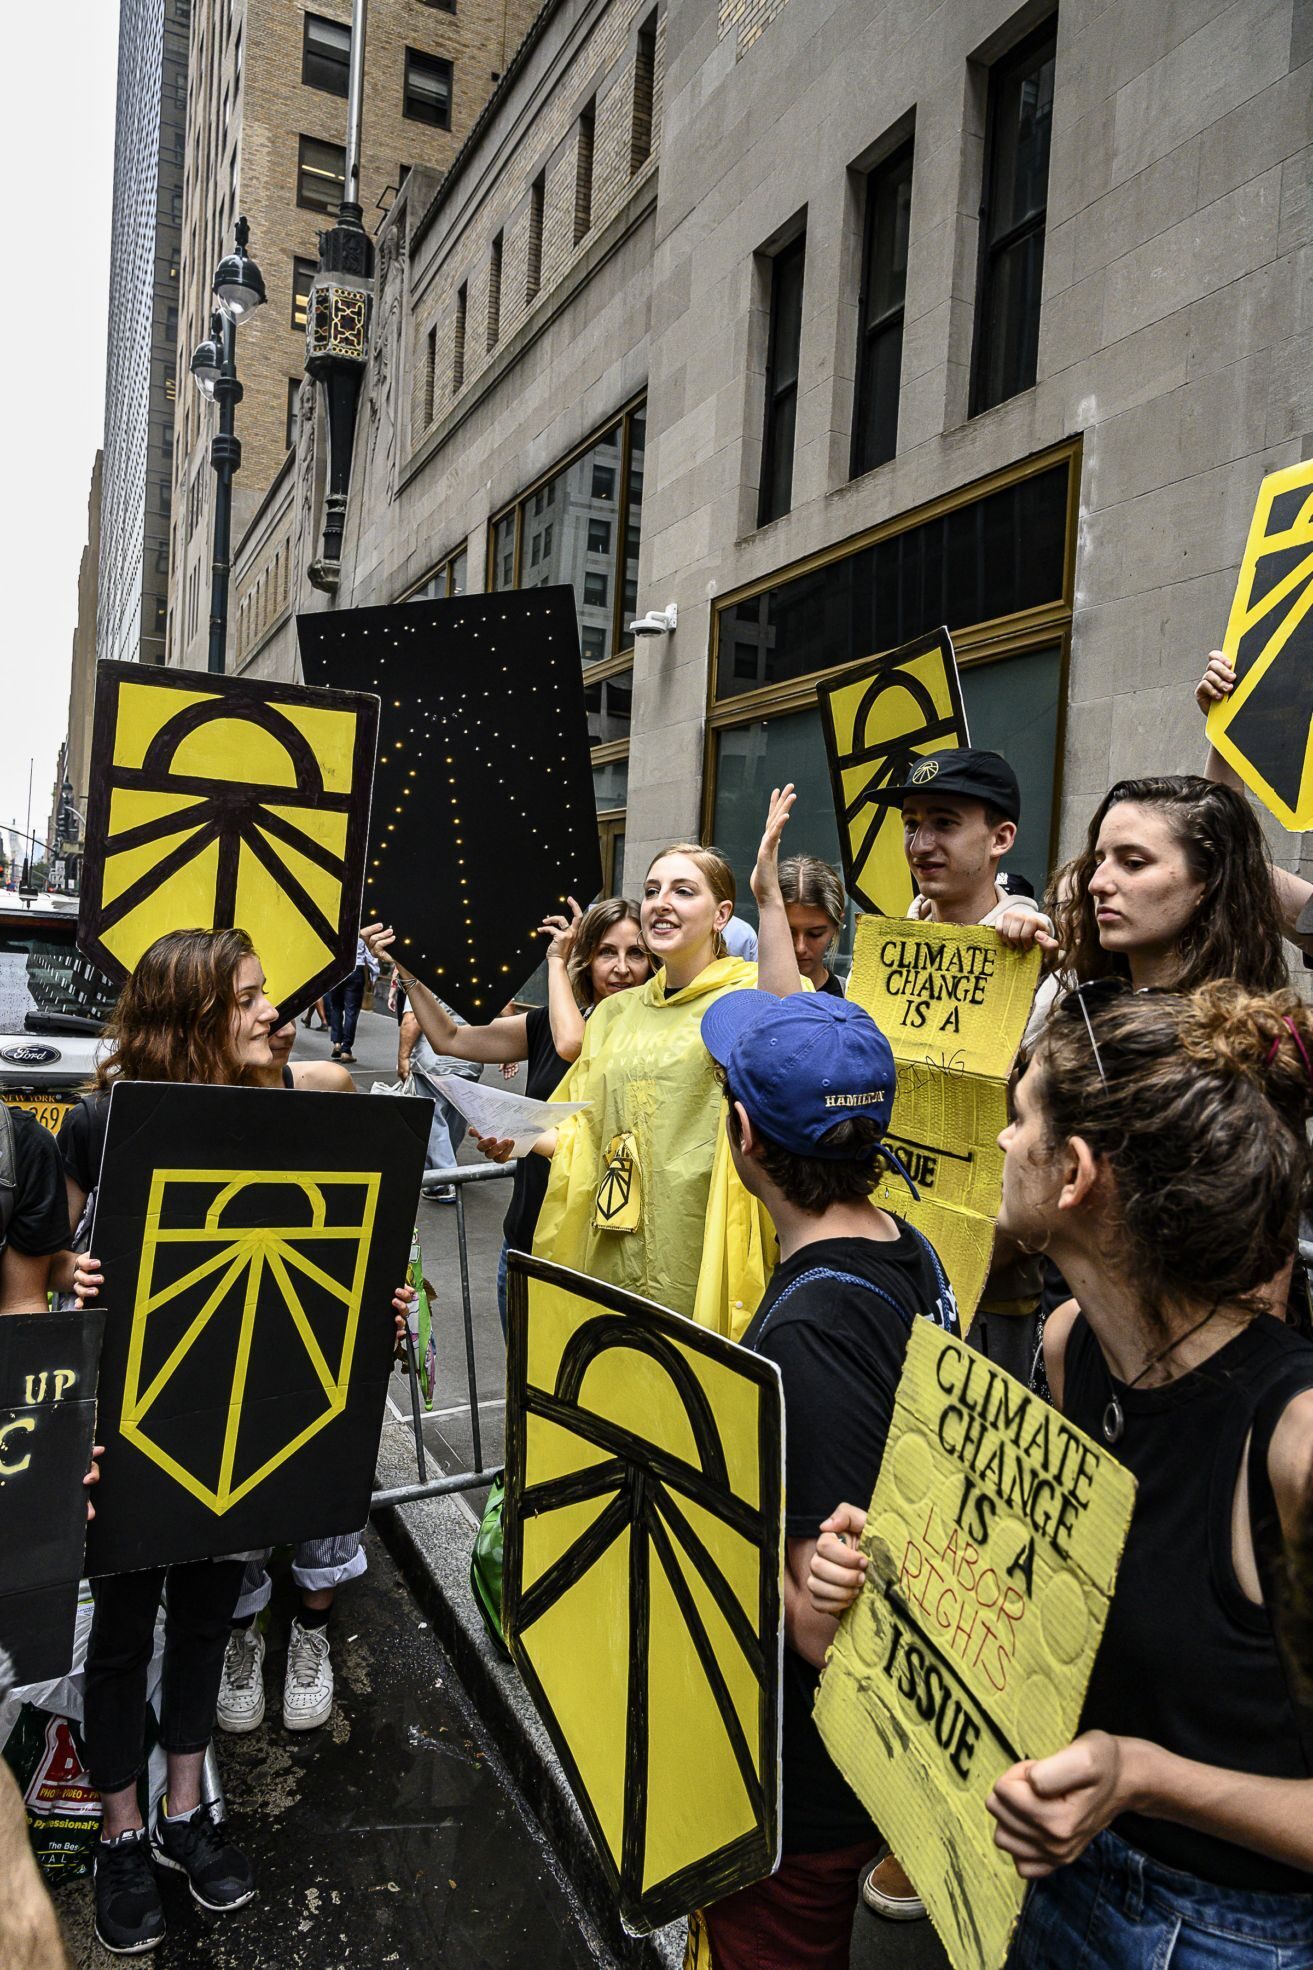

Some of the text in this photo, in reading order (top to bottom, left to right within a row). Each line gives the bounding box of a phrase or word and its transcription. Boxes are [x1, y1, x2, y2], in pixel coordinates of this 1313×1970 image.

[880, 941, 997, 977] CLIMATE
[885, 969, 988, 1005] CHANGE
[900, 999, 960, 1033] IS A
[14, 1047, 47, 1060] Ford
[1, 1094, 56, 1103] NEW YORK
[25, 1369, 76, 1405] UP
[936, 1344, 1100, 1512] CLIMATE
[938, 1403, 1079, 1562] CHANGE
[953, 1474, 1035, 1600] IS A
[922, 1505, 1025, 1657] LABOR
[899, 1540, 1012, 1692] RIGHTS
[883, 1623, 981, 1782] ISSUE
[34, 1818, 100, 1831] Pressional's
[63, 1842, 80, 1851] Bes
